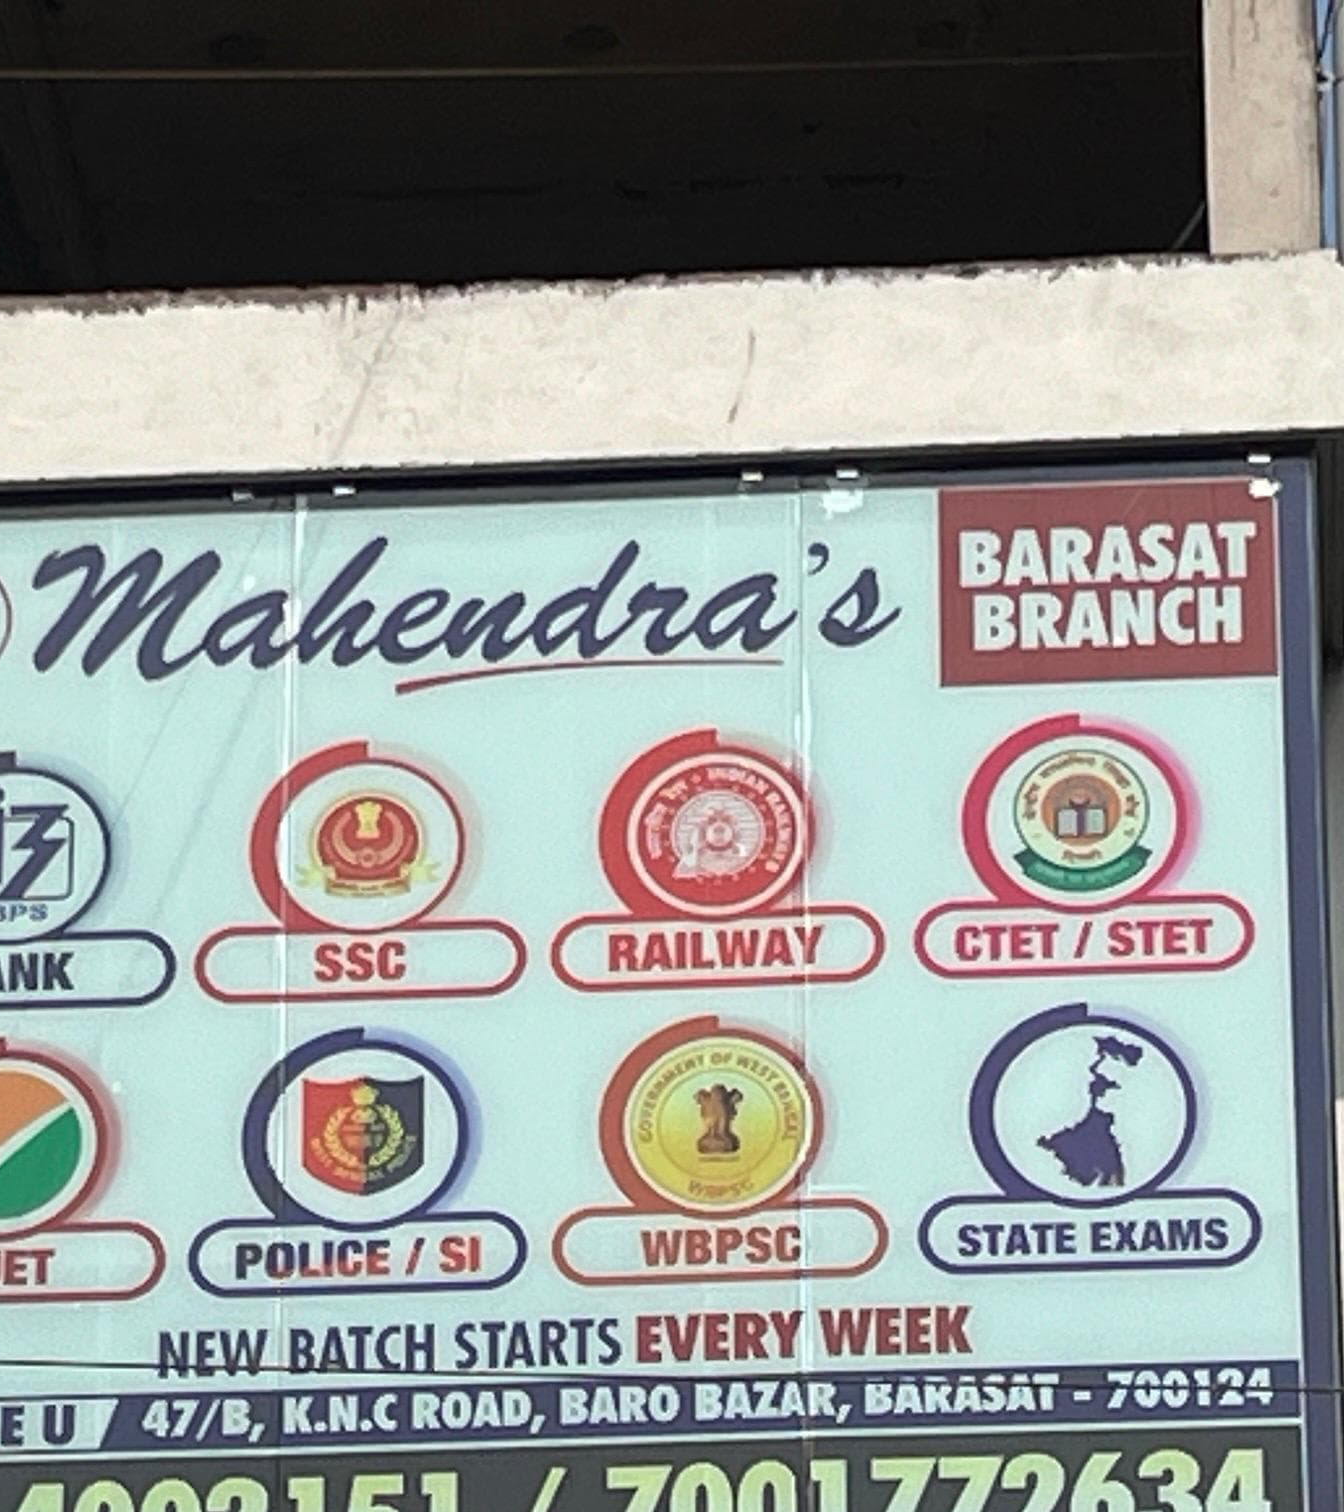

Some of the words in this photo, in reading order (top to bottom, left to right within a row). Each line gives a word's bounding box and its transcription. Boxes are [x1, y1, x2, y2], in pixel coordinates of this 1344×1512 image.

[958, 521, 1257, 588] BARASAT
[32, 536, 902, 681] Mahendra's
[972, 586, 1244, 651] BRANCH
[608, 925, 824, 974] RAILWAY
[956, 923, 1058, 961] CTET
[1074, 920, 1093, 959] /
[1108, 918, 1213, 956] STET
[313, 941, 407, 982] SSC
[710, 1052, 733, 1065] OF
[736, 1055, 778, 1083] WEST
[236, 1240, 392, 1279] POLICE
[406, 1237, 426, 1275] /
[439, 1237, 482, 1273] SI
[640, 1225, 803, 1267] WBPSC
[958, 1222, 1076, 1257] STATE
[1090, 1217, 1230, 1253] EXAMS
[158, 1329, 269, 1379] NEW
[288, 1324, 436, 1373] BATCH
[455, 1316, 621, 1369] STARTS
[635, 1310, 805, 1364] EVERY
[819, 1305, 975, 1356] WEEK
[42, 1405, 76, 1445] U
[141, 1398, 265, 1443] 47/B,
[283, 1394, 400, 1436] K.N.C
[413, 1391, 546, 1434] ROAD,
[559, 1382, 680, 1427] BARO
[695, 1378, 852, 1423] BAZAR,
[864, 1374, 1059, 1416] BARASAT
[1107, 1368, 1274, 1410] 700124
